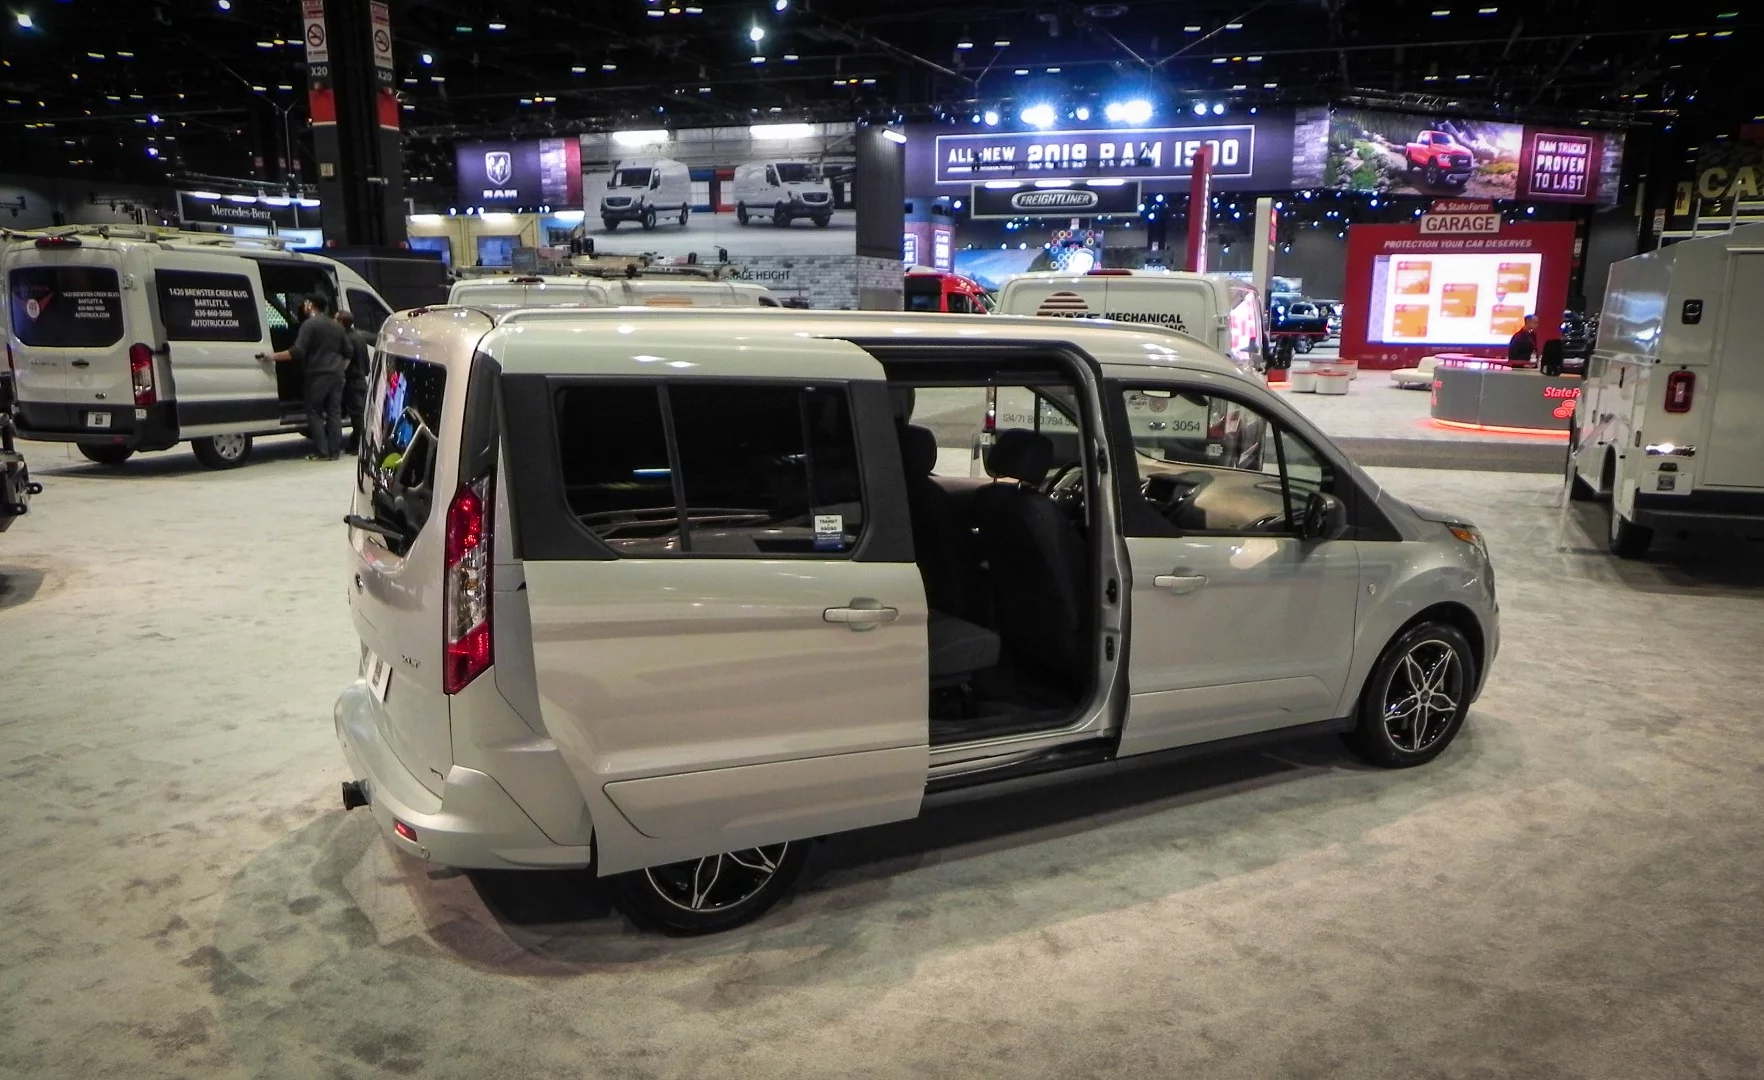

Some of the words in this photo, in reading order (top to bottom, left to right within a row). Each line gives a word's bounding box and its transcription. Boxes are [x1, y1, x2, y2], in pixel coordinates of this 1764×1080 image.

[311, 66, 328, 76] X20
[377, 70, 392, 80] X20
[1538, 140, 1557, 153] RAM
[1028, 143, 1088, 169] 2019
[1100, 142, 1162, 167] RAM
[1536, 154, 1586, 173] PROVEN
[1535, 172, 1550, 188] TO
[1553, 173, 1584, 191] LAST
[483, 189, 517, 198] RAM
[1020, 193, 1090, 205] FREIGHTLINER
[211, 204, 271, 219] Mercedes-Benz
[1426, 216, 1495, 231] GARAGE
[1384, 240, 1438, 248] PROTECTION
[1440, 240, 1464, 248] YOUR
[1465, 240, 1484, 248] CAR
[1485, 239, 1532, 247] DESERVES
[756, 271, 790, 279] HEIGHT
[184, 288, 215, 297] BREWSTER
[215, 289, 233, 297] CREEK
[1105, 312, 1183, 324] MECHANICAL
[1172, 420, 1200, 432] 3054
